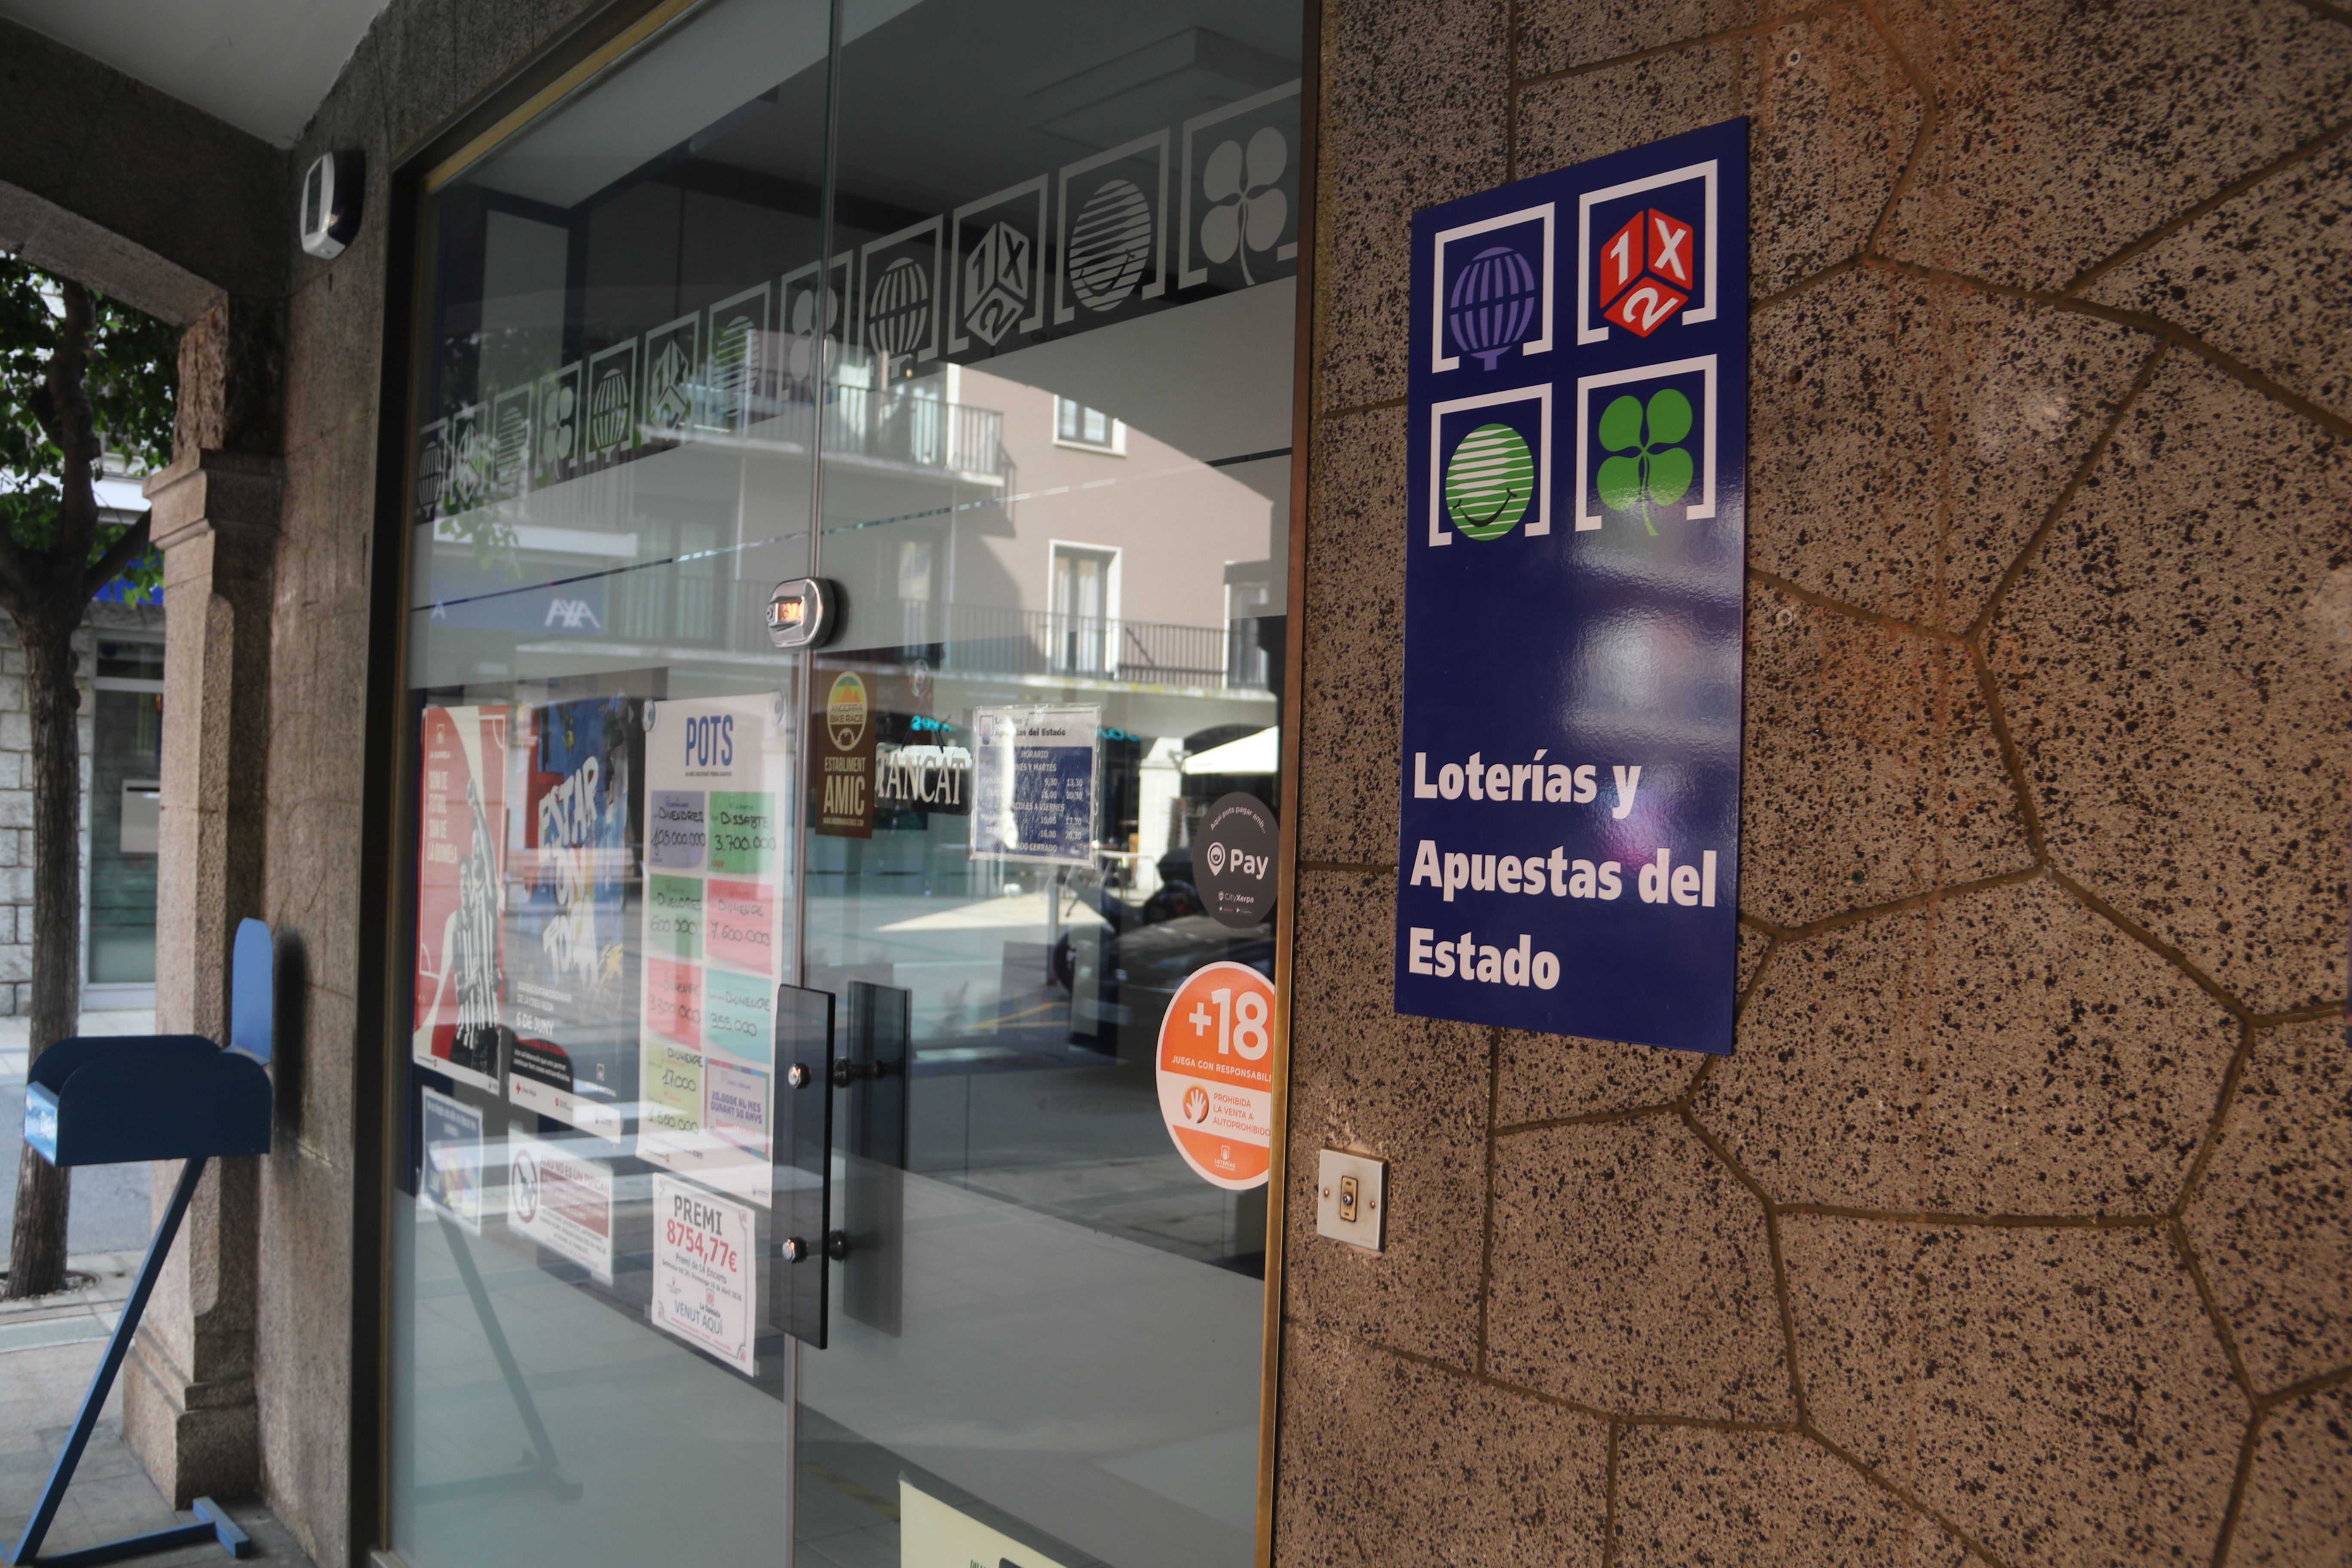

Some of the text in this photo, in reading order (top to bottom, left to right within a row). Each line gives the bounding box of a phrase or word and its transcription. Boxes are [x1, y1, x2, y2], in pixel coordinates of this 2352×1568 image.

[1610, 217, 1687, 285] 1 X
[1622, 287, 1679, 331] 2
[830, 703, 863, 712] ANDORRA
[830, 714, 864, 723] BIKE RACE
[1028, 728, 1039, 736] del
[1041, 727, 1066, 736] Estado
[685, 714, 734, 767] POTS
[1021, 750, 1049, 758] HORARIO
[824, 756, 866, 772] ESTABLIMENT
[1033, 763, 1057, 772] MARTES
[876, 751, 966, 805] TANCAT
[1413, 748, 1642, 819] Loterías y
[823, 775, 866, 816] AMIC
[1039, 802, 1065, 812] VIERNES
[1222, 807, 1235, 819] pots
[1235, 806, 1252, 817] pagar
[1029, 843, 1058, 853] CERRADO
[1230, 848, 1268, 880] Pay
[1409, 839, 1717, 907] Apuestas del
[1224, 892, 1255, 904] CityXerpa
[1408, 926, 1561, 990] Estado
[516, 1011, 554, 1037] 6 DE JUNY
[1188, 987, 1268, 1061] +18
[1172, 1055, 1196, 1067] JUEGA
[1197, 1060, 1214, 1071] CON
[710, 1101, 735, 1116] DURANT
[748, 1100, 761, 1113] MES
[1213, 1092, 1251, 1108] PROHIBIDA
[1213, 1104, 1254, 1121] LA VENTA A
[1213, 1118, 1271, 1137] AUTOPROHIBIDO
[674, 1194, 723, 1237] PREMI
[667, 1218, 737, 1273] 8754,77€
[675, 1252, 691, 1267] Premi
[691, 1260, 698, 1269] de
[674, 1298, 700, 1324] VENUT
[701, 1313, 723, 1337] AQUÍ
